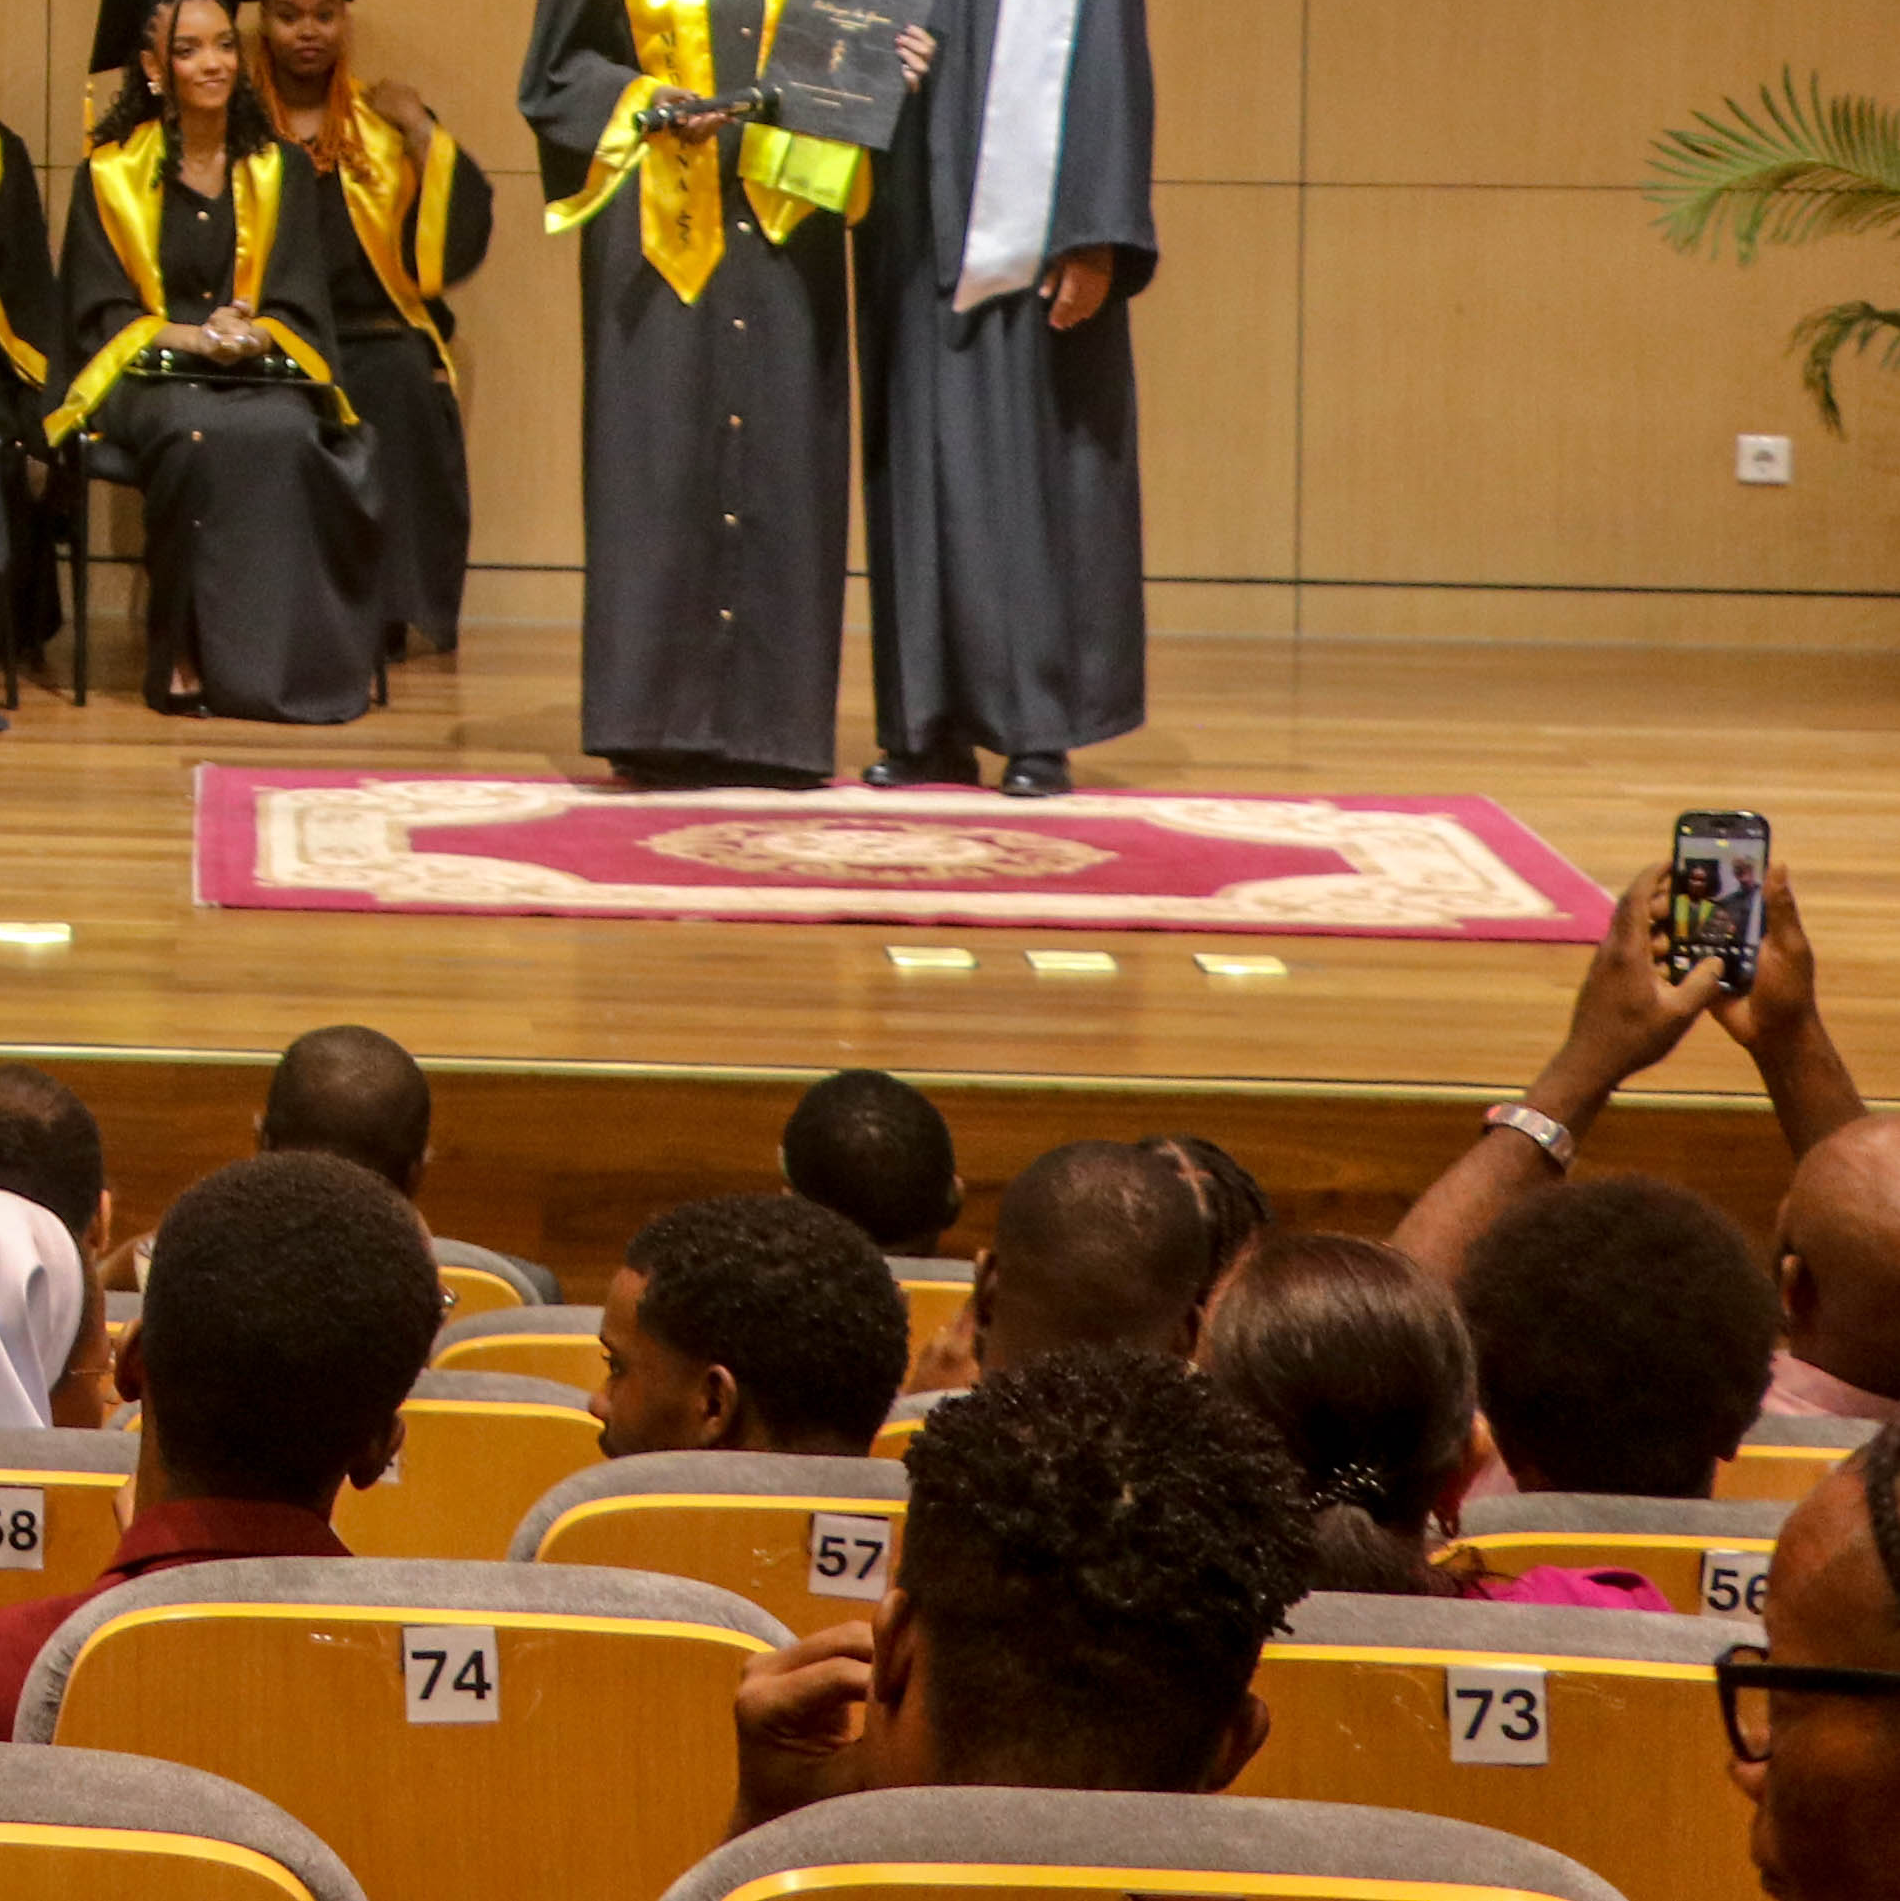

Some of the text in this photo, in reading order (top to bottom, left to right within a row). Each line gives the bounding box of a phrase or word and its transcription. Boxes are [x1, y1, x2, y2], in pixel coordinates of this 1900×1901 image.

[817, 1535, 883, 1579] 57
[411, 1650, 492, 1700] 74
[1455, 1688, 1540, 1741] 73
